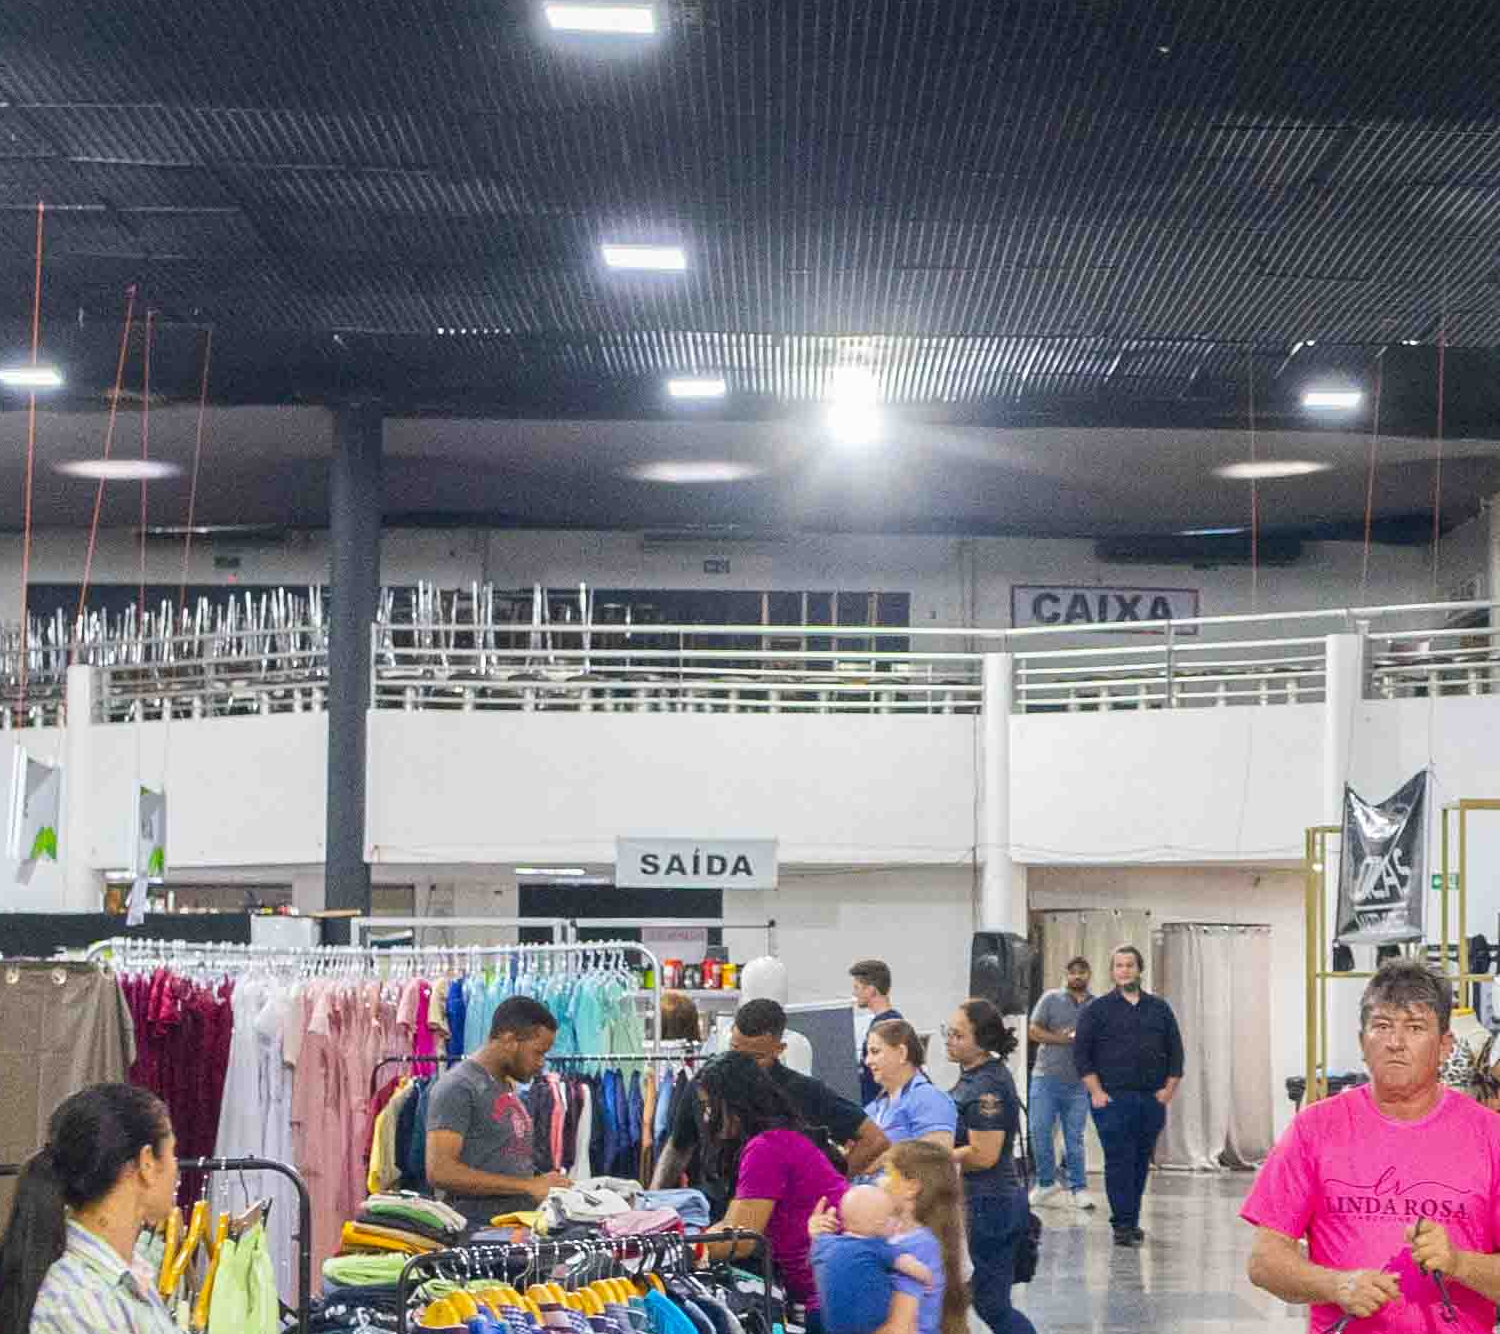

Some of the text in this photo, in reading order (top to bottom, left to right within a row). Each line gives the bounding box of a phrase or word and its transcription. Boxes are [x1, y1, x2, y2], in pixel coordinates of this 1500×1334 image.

[1032, 591, 1174, 624] CAIXA
[640, 843, 754, 876] SAÍDA
[1325, 1196, 1470, 1220] LINDA ROSA
